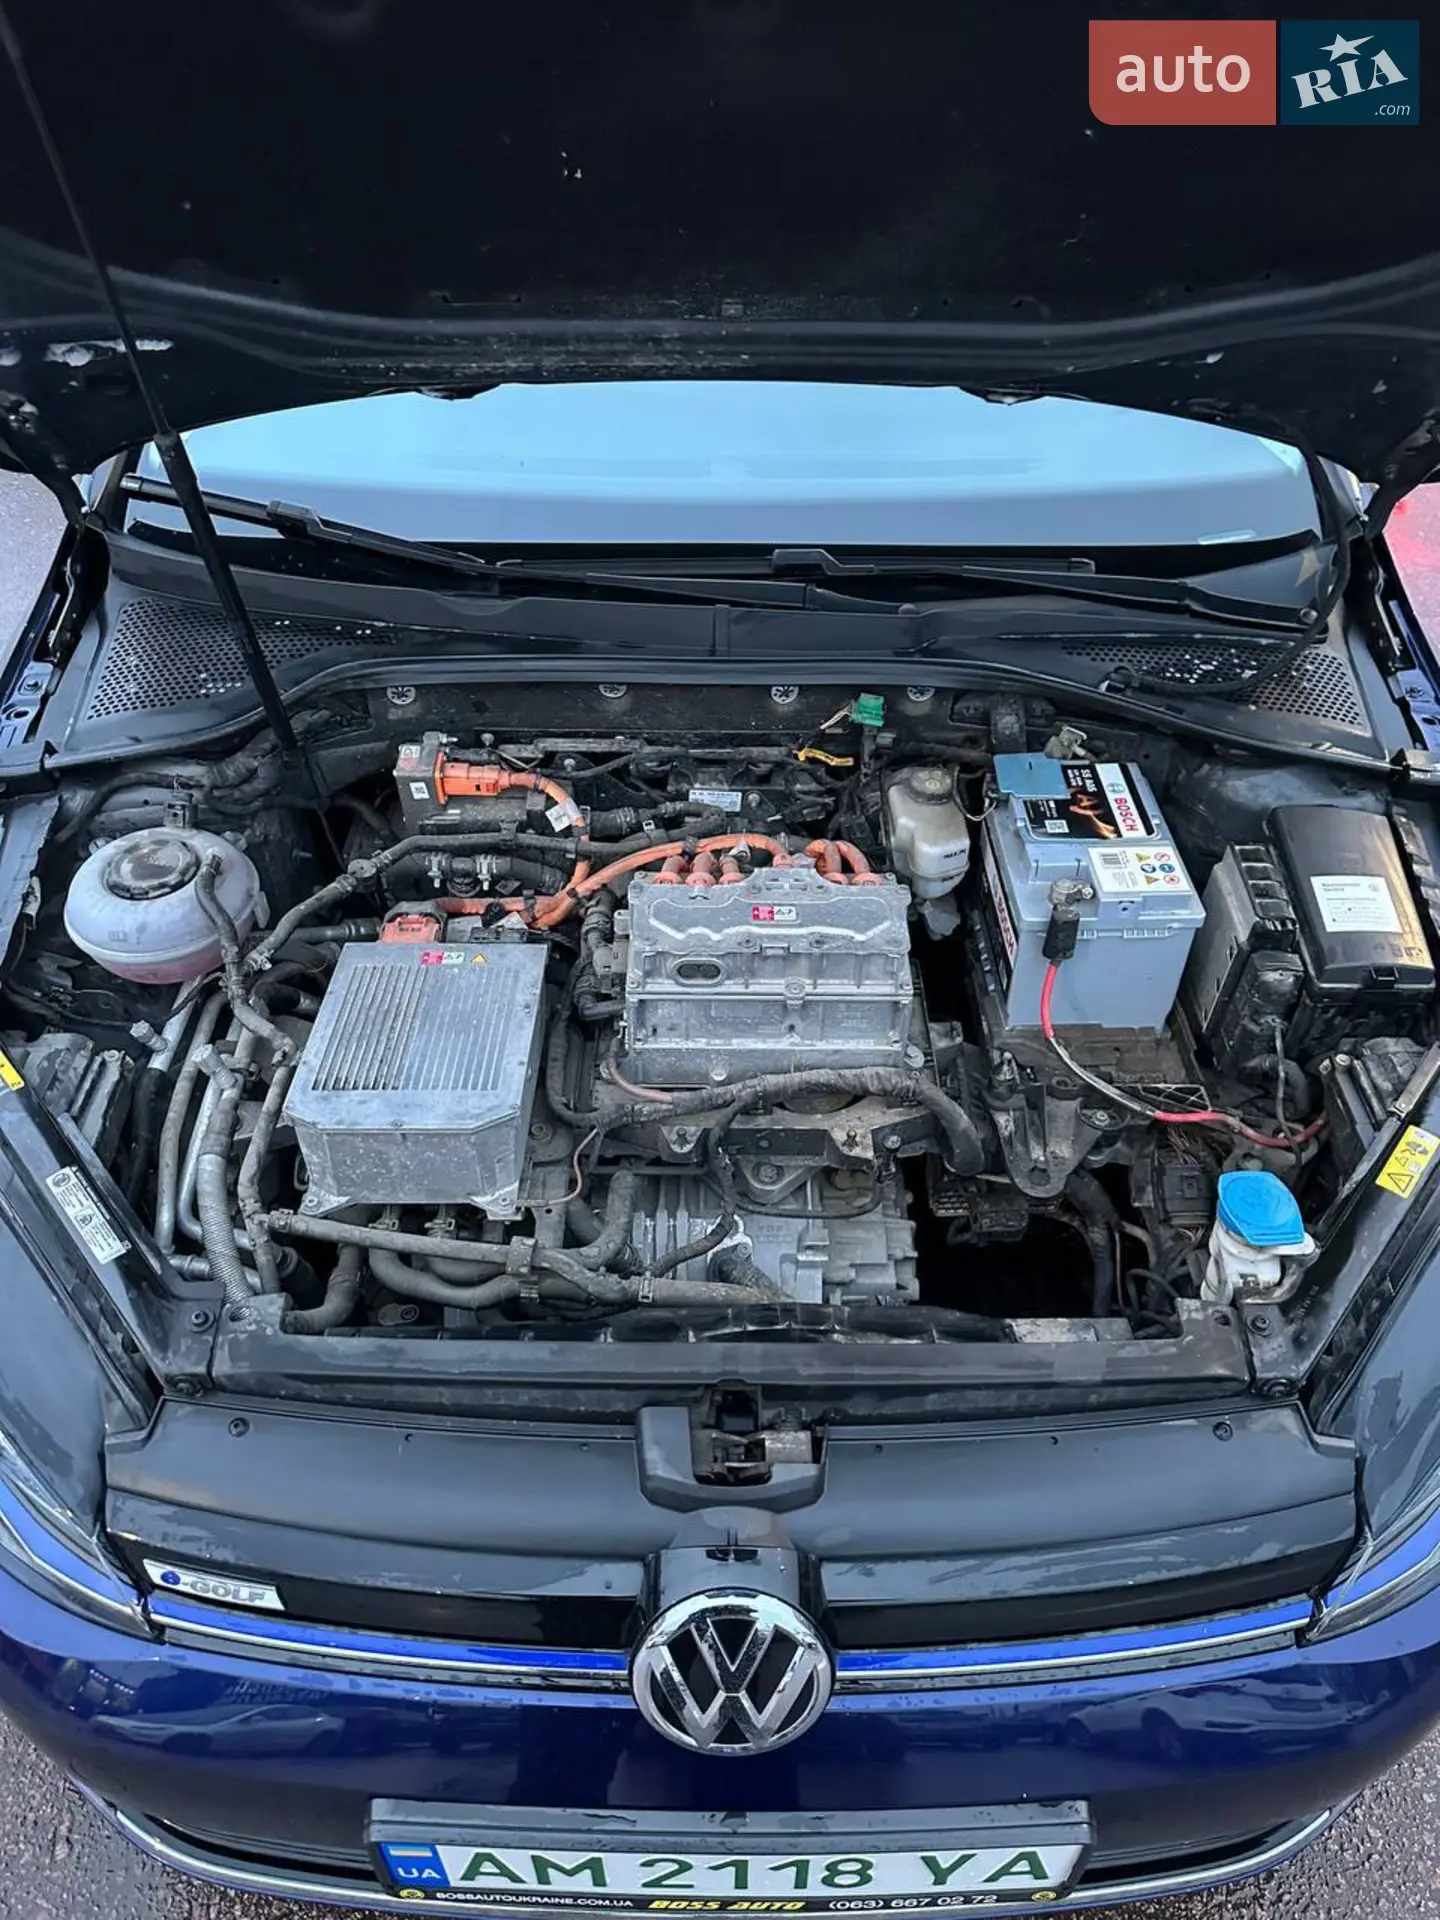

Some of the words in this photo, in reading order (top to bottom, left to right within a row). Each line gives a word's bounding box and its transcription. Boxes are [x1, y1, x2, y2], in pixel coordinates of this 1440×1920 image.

[1114, 797, 1140, 832] BOSCH
[397, 1867, 442, 1879] UA
[459, 1851, 608, 1888] AM
[638, 1857, 874, 1890] 2118
[919, 1850, 1050, 1886] YA
[436, 1891, 634, 1907] BOSSAUTOUKRAINE.COM.UA
[648, 1899, 721, 1910] BOSS
[727, 1901, 805, 1911] AUTO
[829, 1899, 884, 1910] (063)
[891, 1897, 930, 1909] 667
[936, 1895, 965, 1906] 02
[971, 1893, 999, 1905] 72
